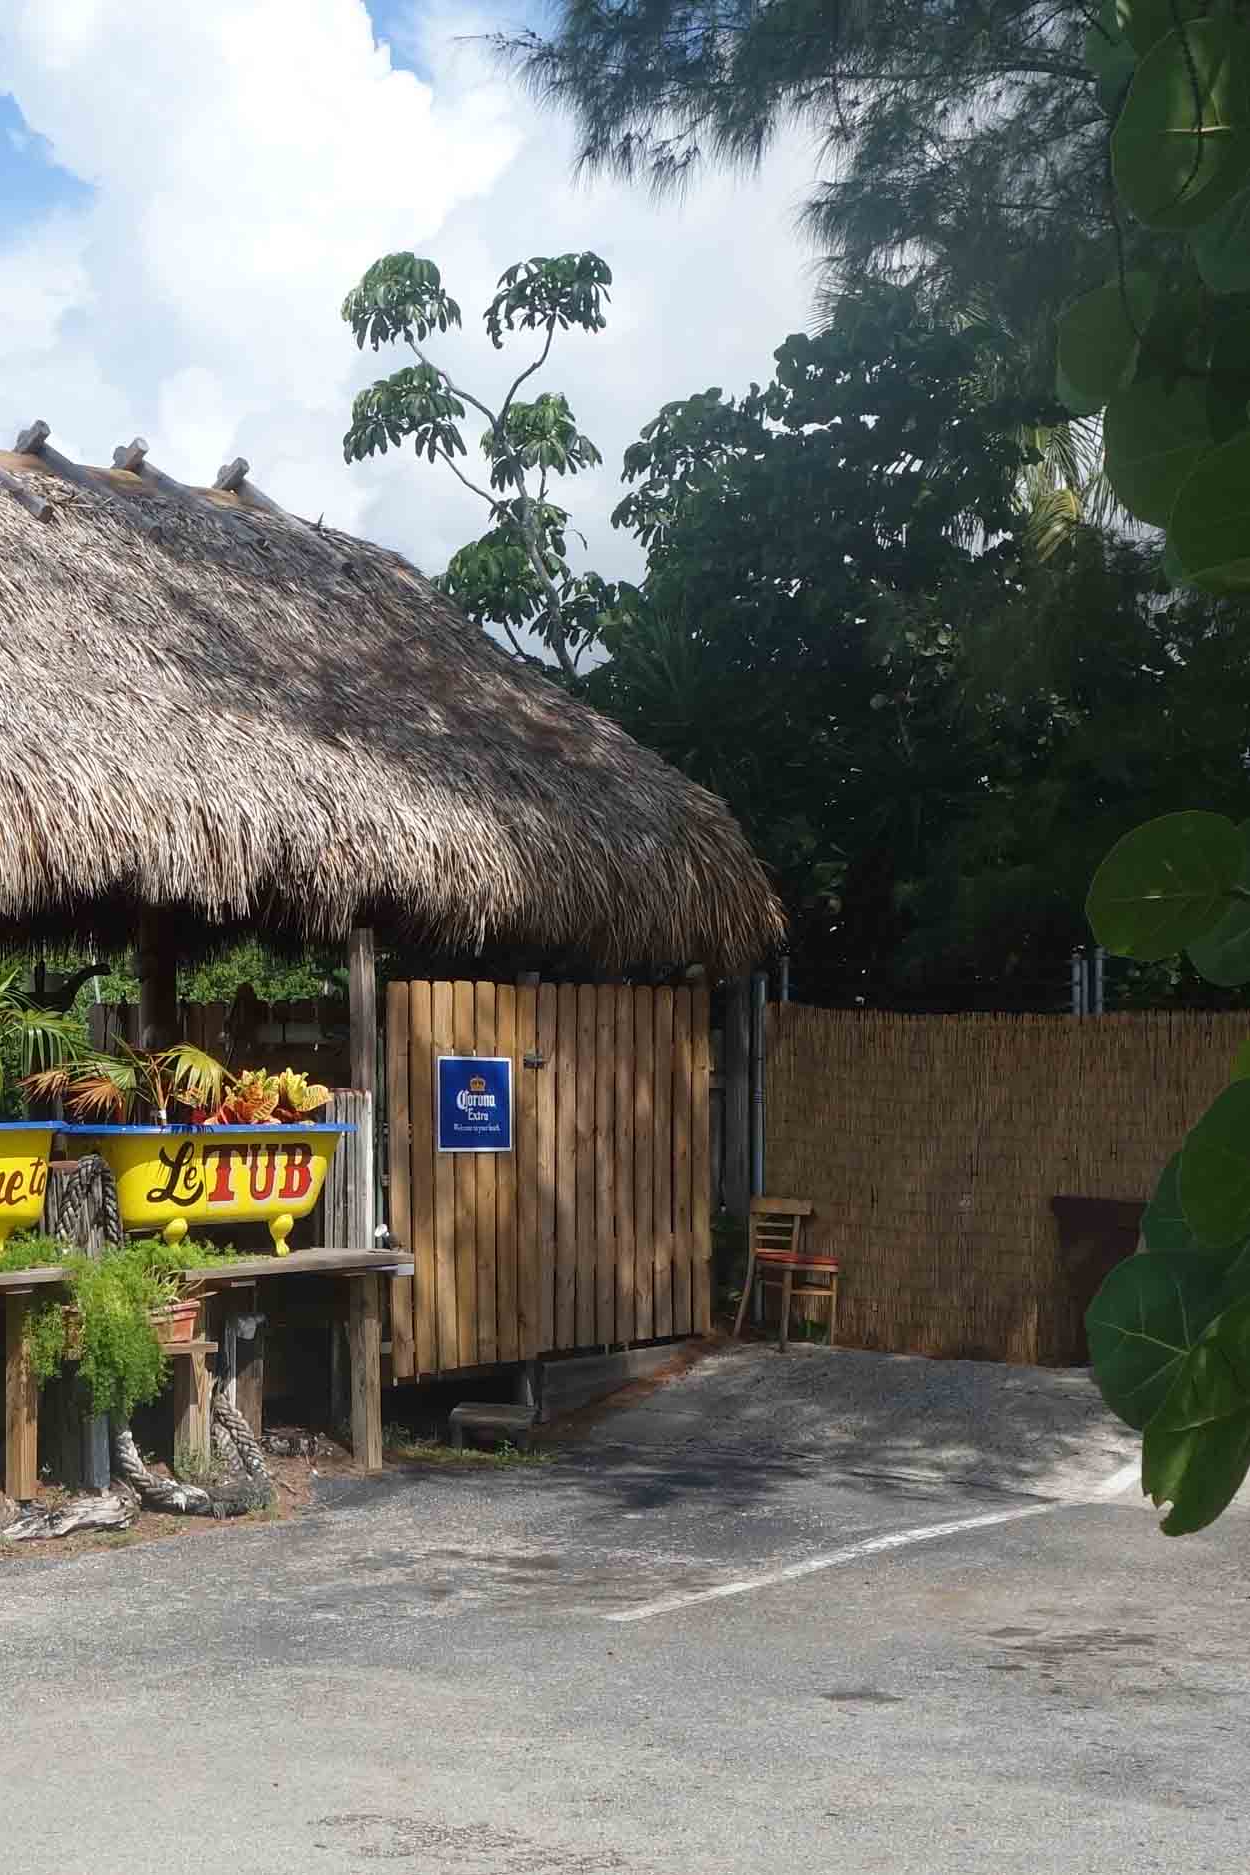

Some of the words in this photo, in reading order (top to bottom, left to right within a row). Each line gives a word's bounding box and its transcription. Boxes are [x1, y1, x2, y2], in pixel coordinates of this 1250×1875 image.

[456, 1090, 496, 1111] Corona
[468, 1108, 489, 1120] Extra
[29, 1156, 46, 1196] to
[146, 1141, 203, 1207] Le
[201, 1143, 313, 1202] TUB
